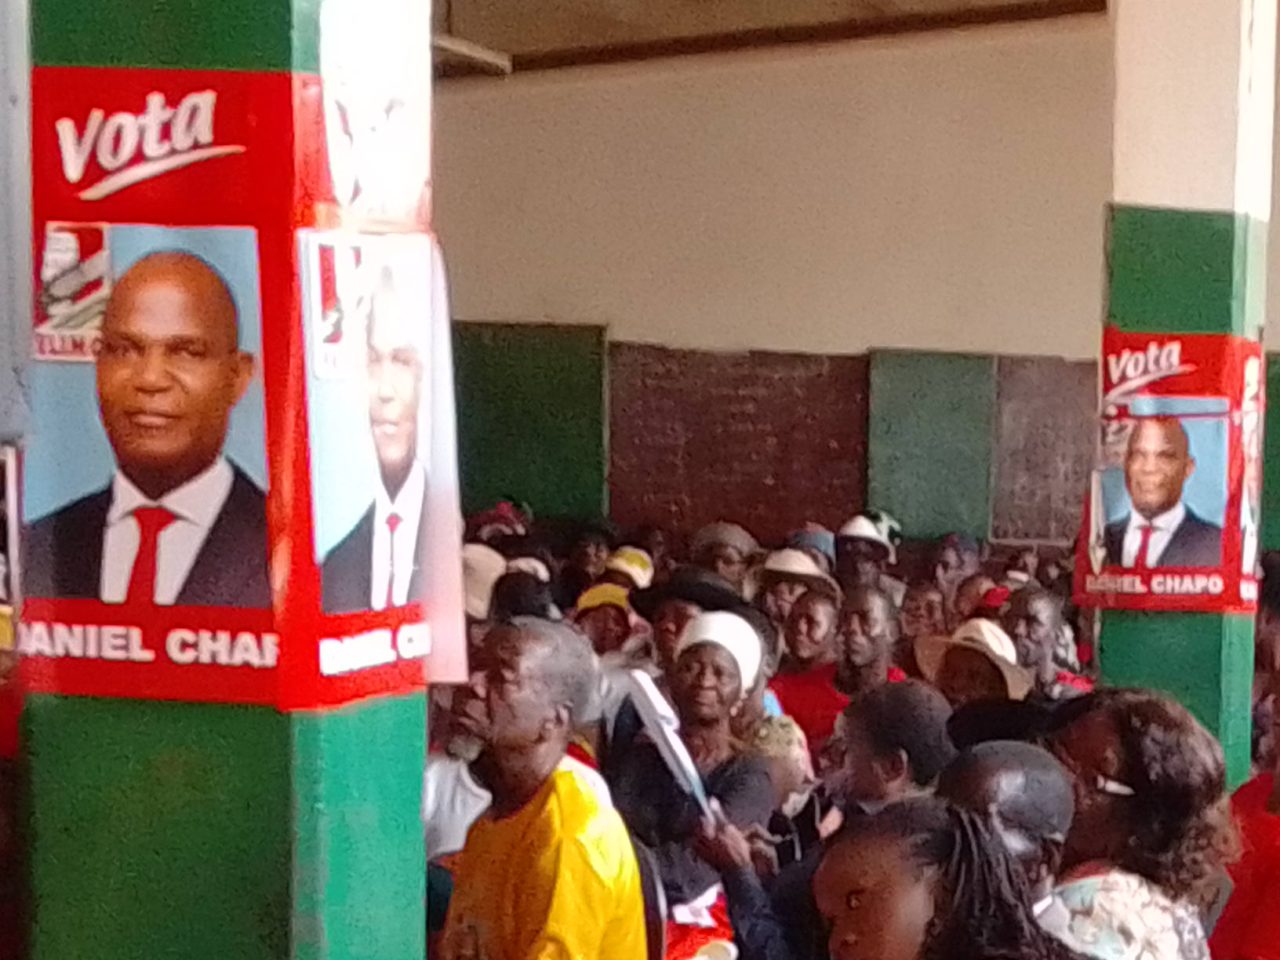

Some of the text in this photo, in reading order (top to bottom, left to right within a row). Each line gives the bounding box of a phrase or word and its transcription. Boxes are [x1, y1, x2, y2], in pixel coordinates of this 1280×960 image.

[55, 90, 218, 183] Vota
[1106, 340, 1182, 385] Vota
[1151, 573, 1225, 594] CHAPO
